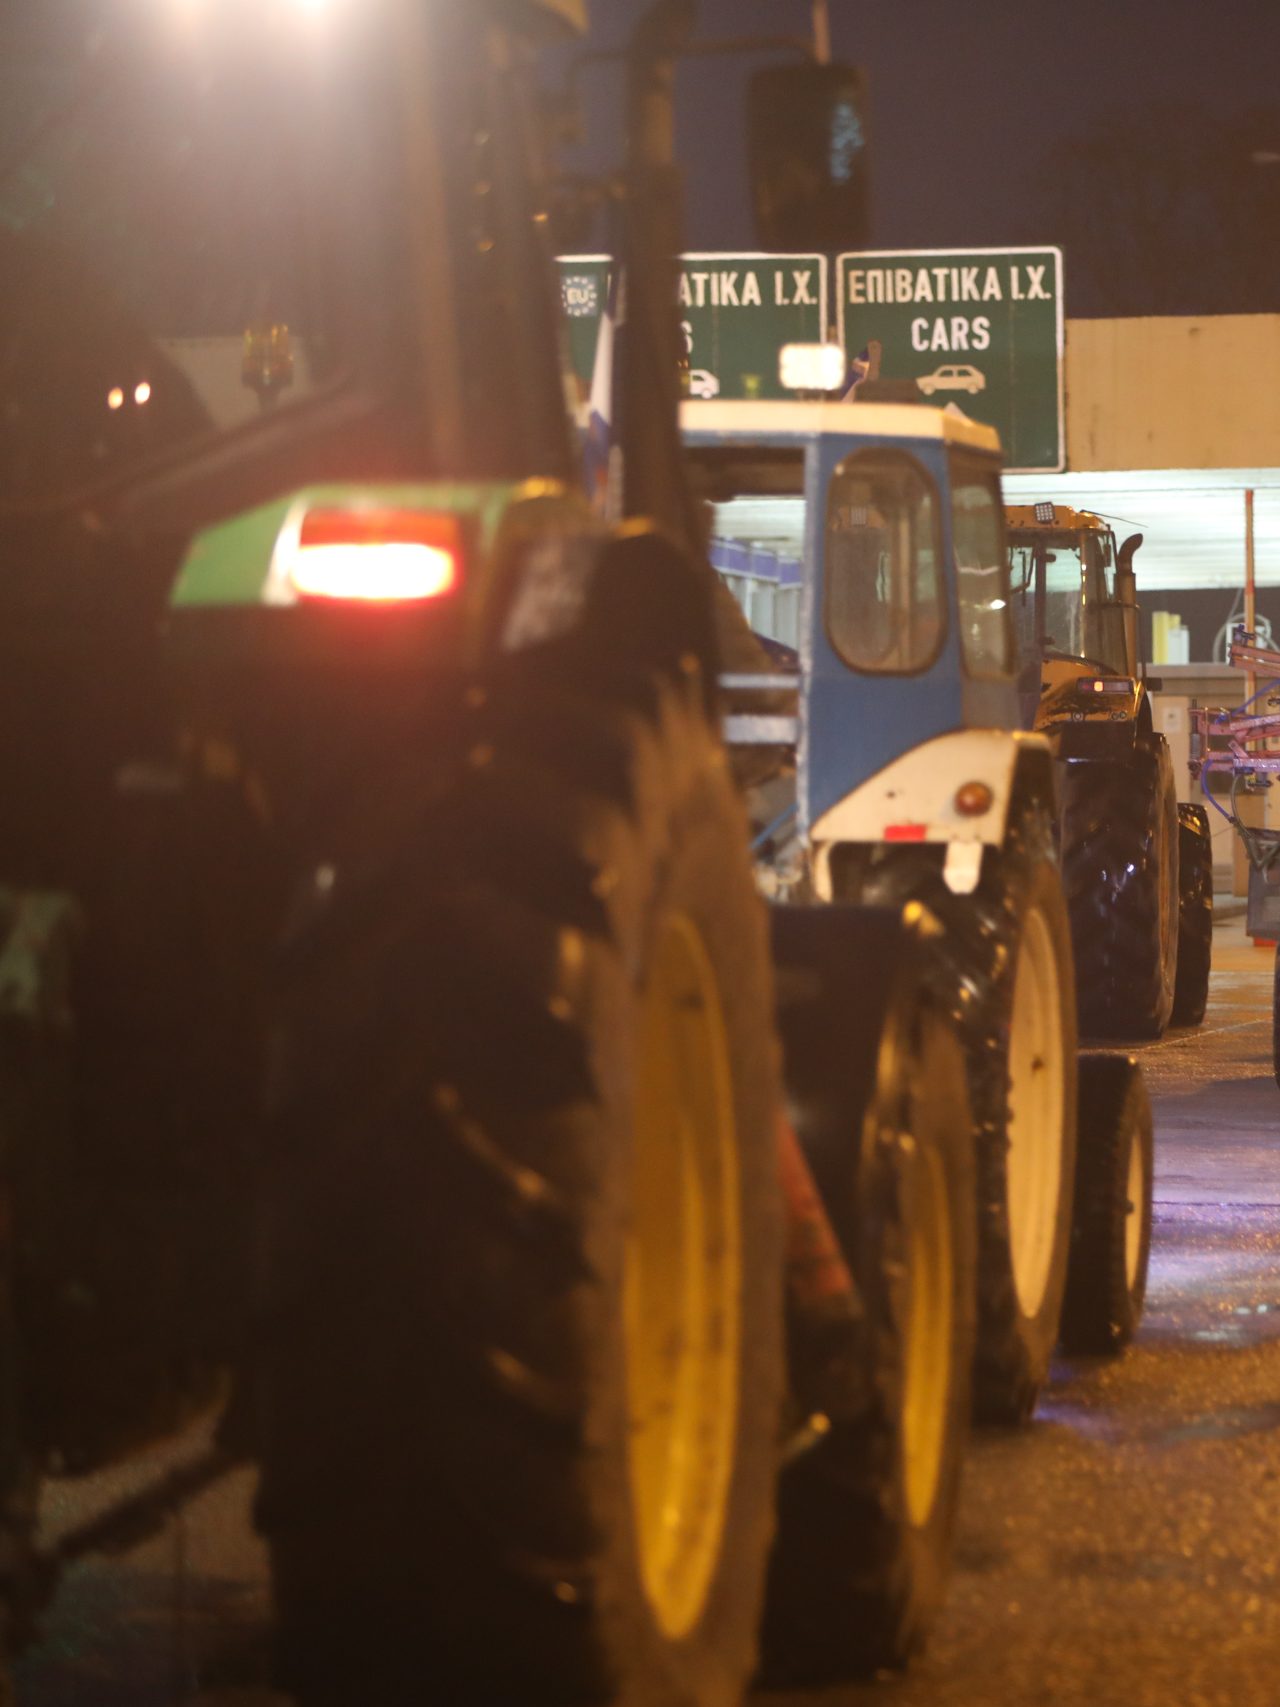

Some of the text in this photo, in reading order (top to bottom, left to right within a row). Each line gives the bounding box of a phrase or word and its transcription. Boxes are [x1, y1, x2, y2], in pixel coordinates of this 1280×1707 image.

[567, 287, 589, 305] EU
[680, 271, 762, 307] ΑΤΙΚΑ
[849, 266, 1003, 304] ΕΠΙΒΑΤΙΚΑ
[911, 316, 990, 352] CARS
